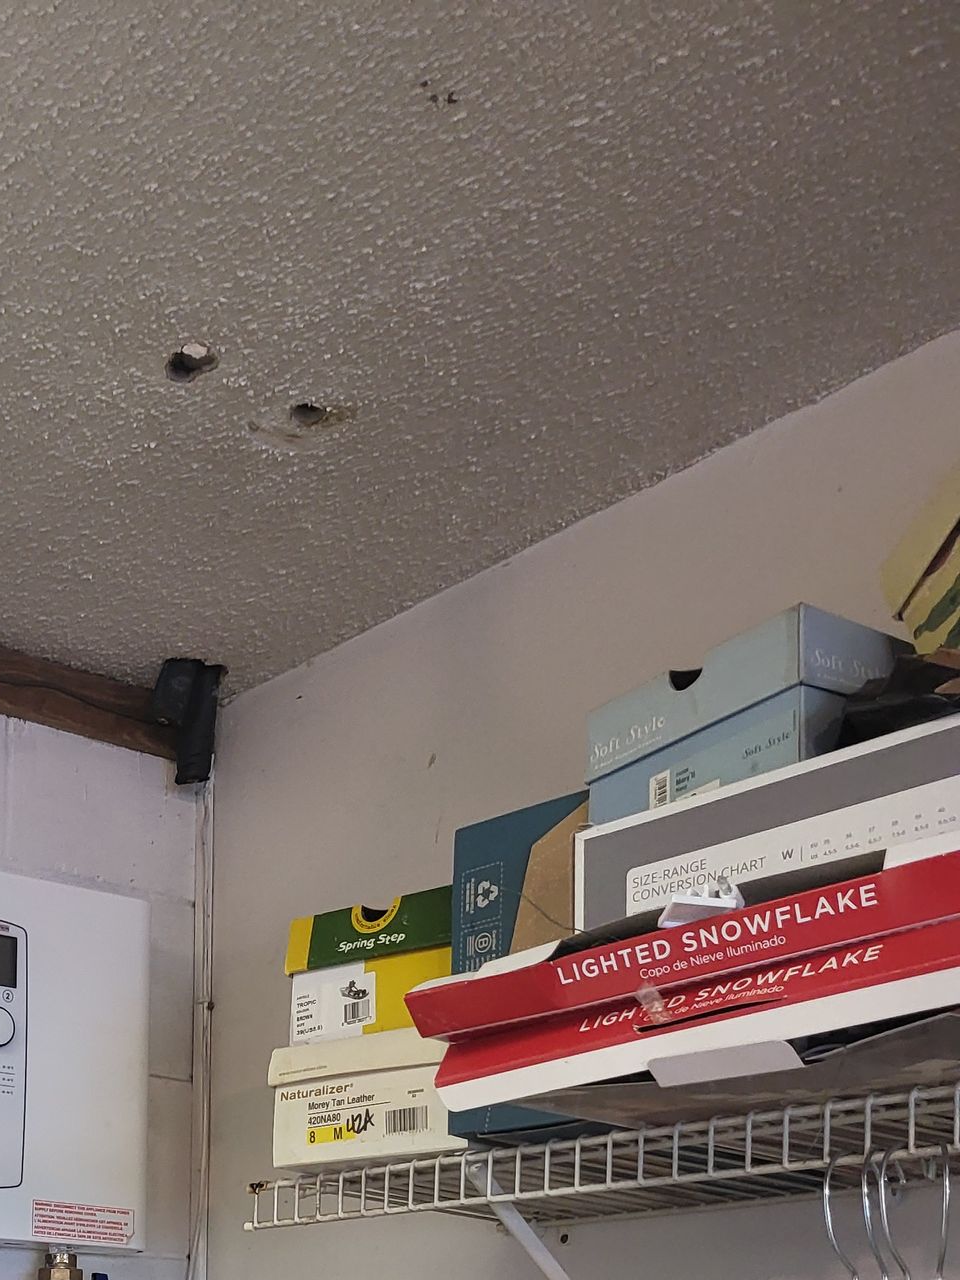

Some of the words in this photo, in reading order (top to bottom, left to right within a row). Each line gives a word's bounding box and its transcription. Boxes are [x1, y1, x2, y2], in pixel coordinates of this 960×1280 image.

[589, 737, 620, 763] Soft
[626, 716, 665, 745] Style
[742, 746, 762, 760] Soft
[764, 731, 790, 749] Style
[781, 848, 794, 861] W
[632, 858, 707, 889] SIZE-RANGE
[632, 871, 717, 902] CONVERSION
[721, 856, 767, 878] CHART
[337, 938, 375, 954] Spring
[376, 932, 406, 945] Step
[557, 939, 672, 986] LIGHTED
[681, 882, 879, 952] SNOWFLAKE
[639, 963, 672, 980] Copo
[672, 958, 689, 970] de
[690, 950, 725, 966] Nieve
[697, 944, 884, 1001] SNOWFLAKE
[296, 999, 317, 1009] TROPIC
[308, 1100, 330, 1112] Morey
[332, 1098, 345, 1108] Tan
[347, 1093, 375, 1105] Leather
[307, 1112, 341, 1126] 420NA80
[309, 1130, 316, 1144] 8
[334, 1127, 343, 1140] M
